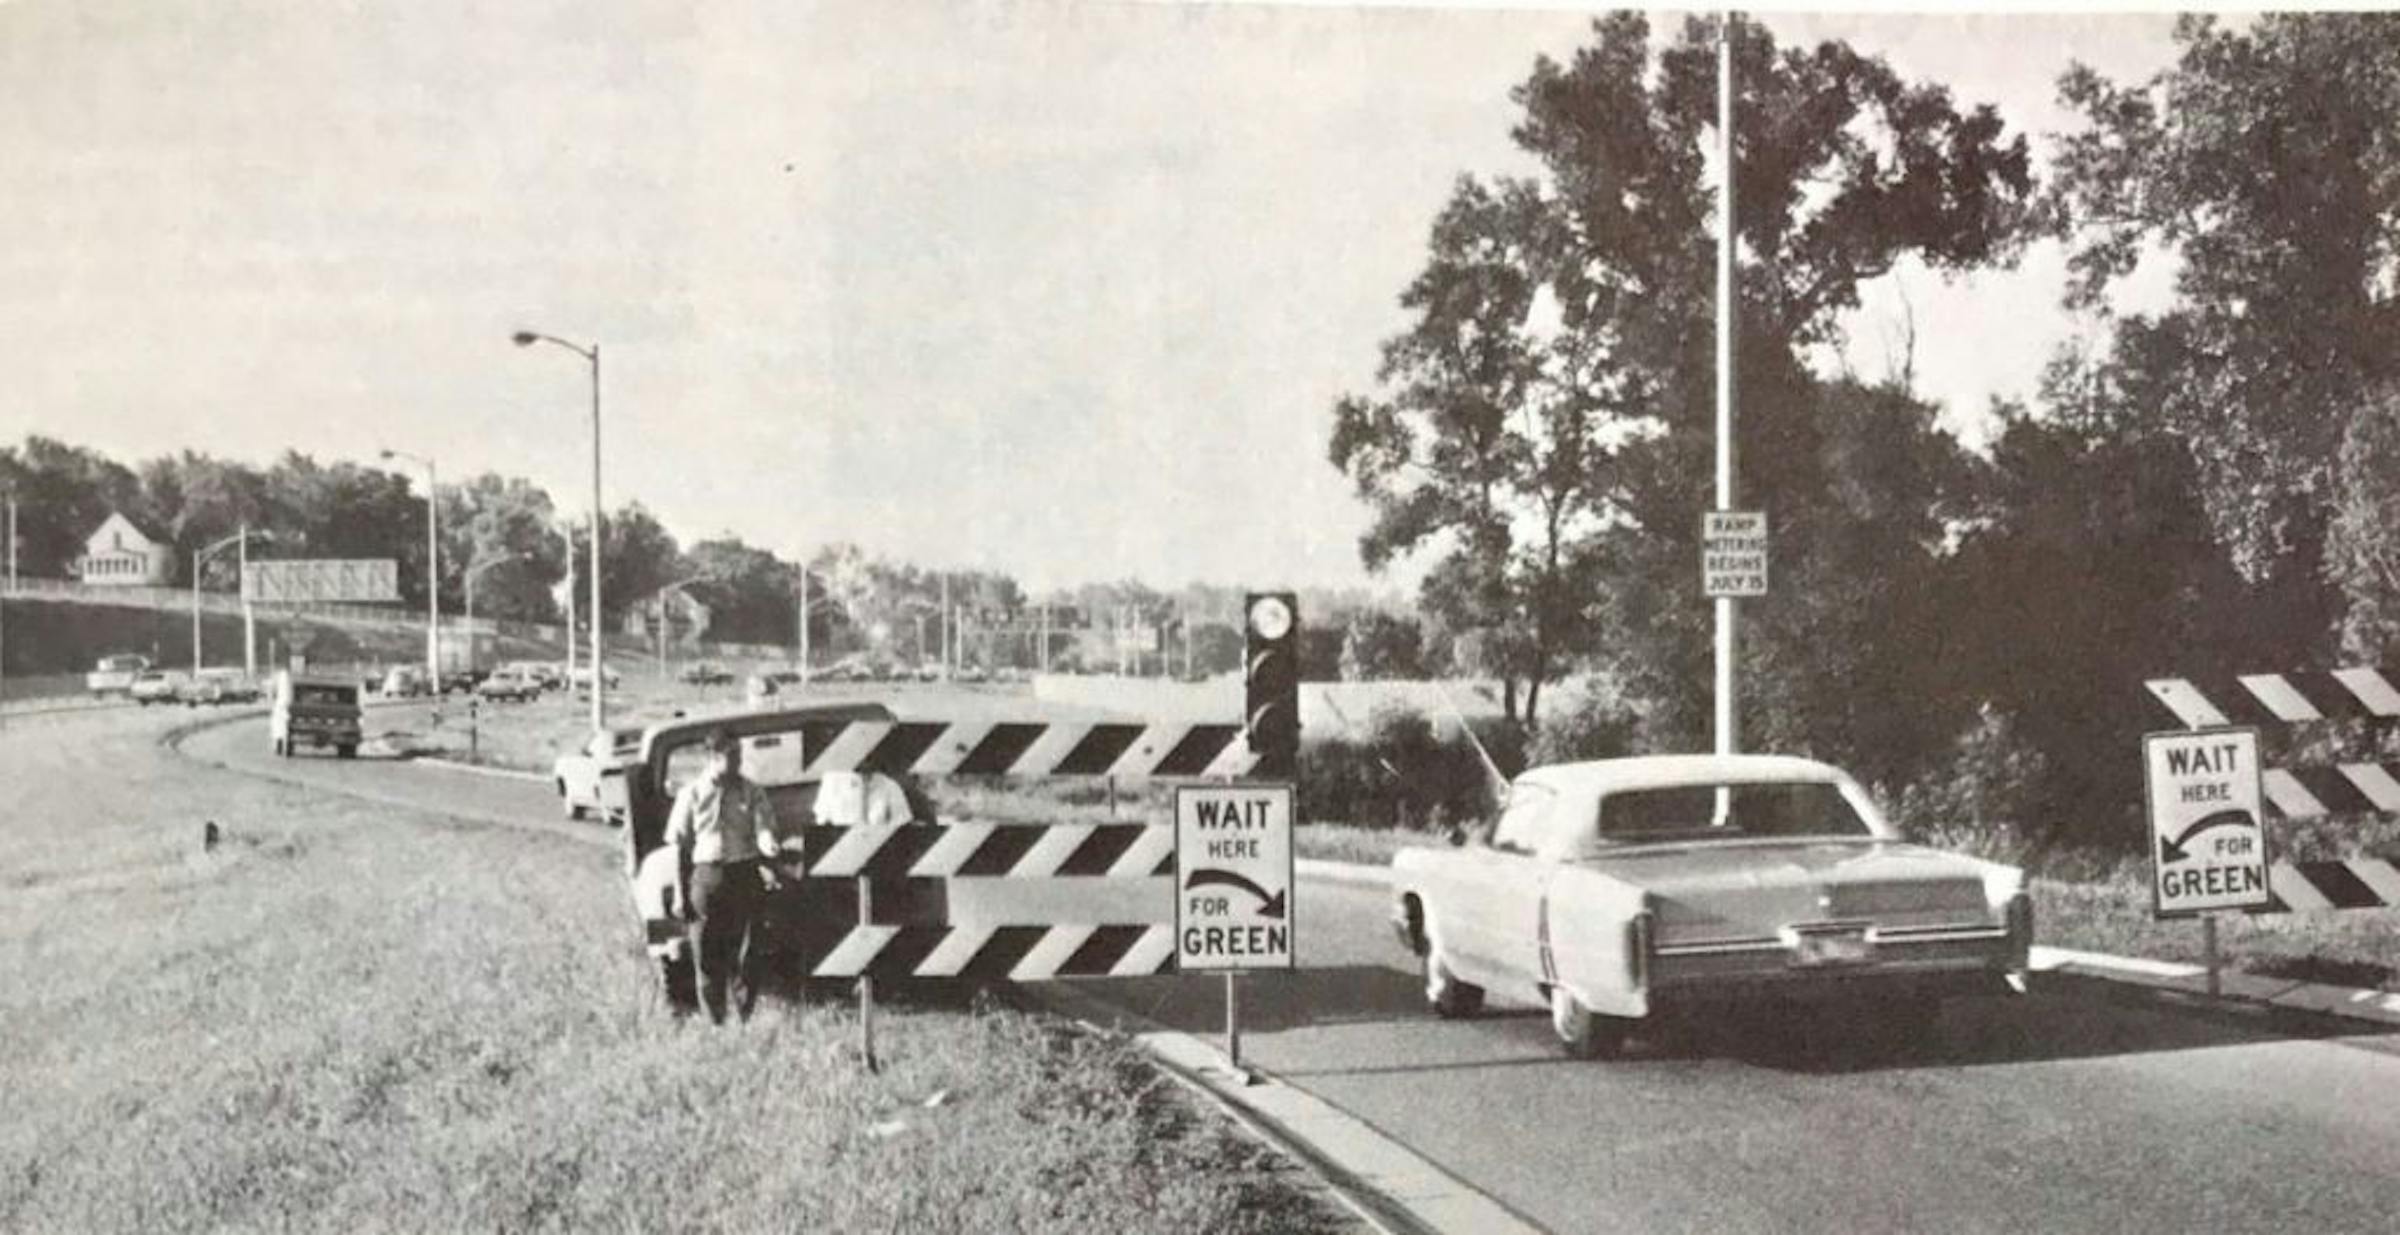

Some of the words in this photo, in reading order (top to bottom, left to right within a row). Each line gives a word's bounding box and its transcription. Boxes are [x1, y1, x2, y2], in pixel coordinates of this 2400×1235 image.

[2167, 744, 2238, 776] WAIT
[2182, 782, 2232, 803] HERE
[1197, 800, 1271, 829] WAIT
[1208, 840, 1259, 858] HERE
[2215, 837, 2252, 855] FOR
[2163, 865, 2263, 898] GREEN
[1190, 897, 1229, 916] FOR
[1184, 926, 1287, 955] GREEN
